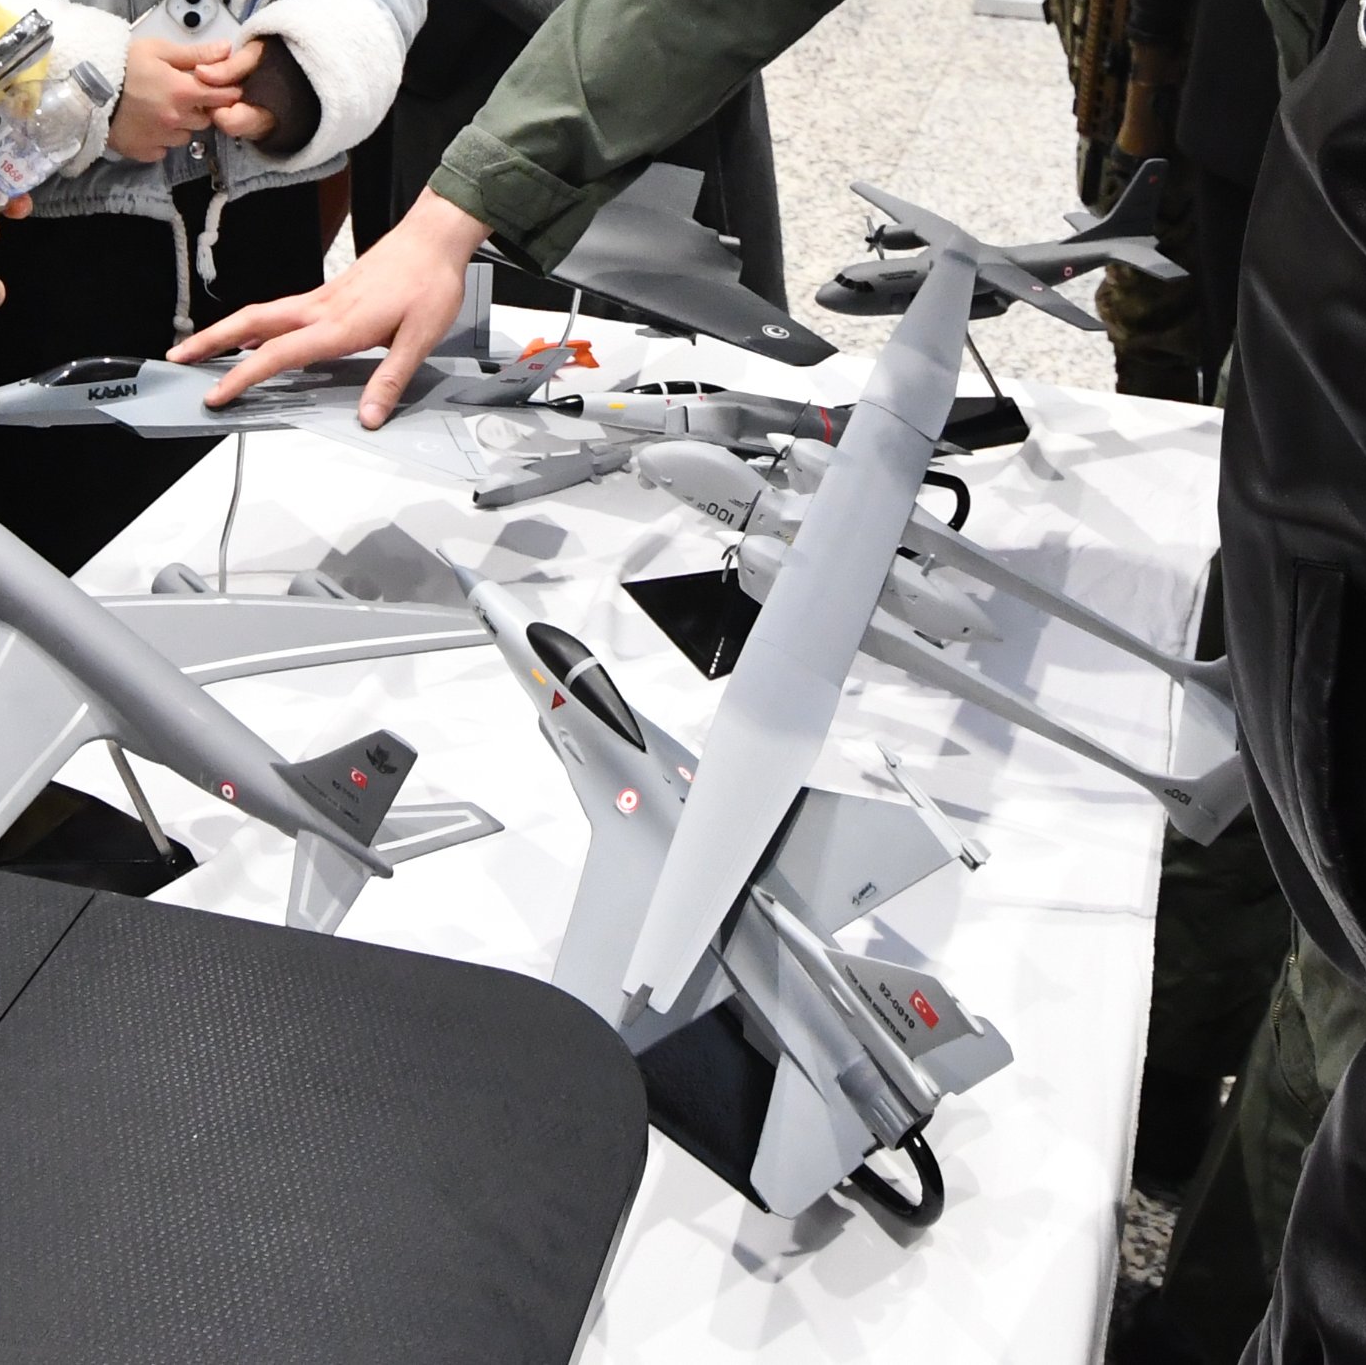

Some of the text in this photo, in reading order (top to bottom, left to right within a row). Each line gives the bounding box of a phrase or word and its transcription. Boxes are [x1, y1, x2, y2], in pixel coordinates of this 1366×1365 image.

[0, 160, 23, 182] 1868
[87, 383, 137, 401] KAAN
[878, 982, 915, 1030] 92-0010
